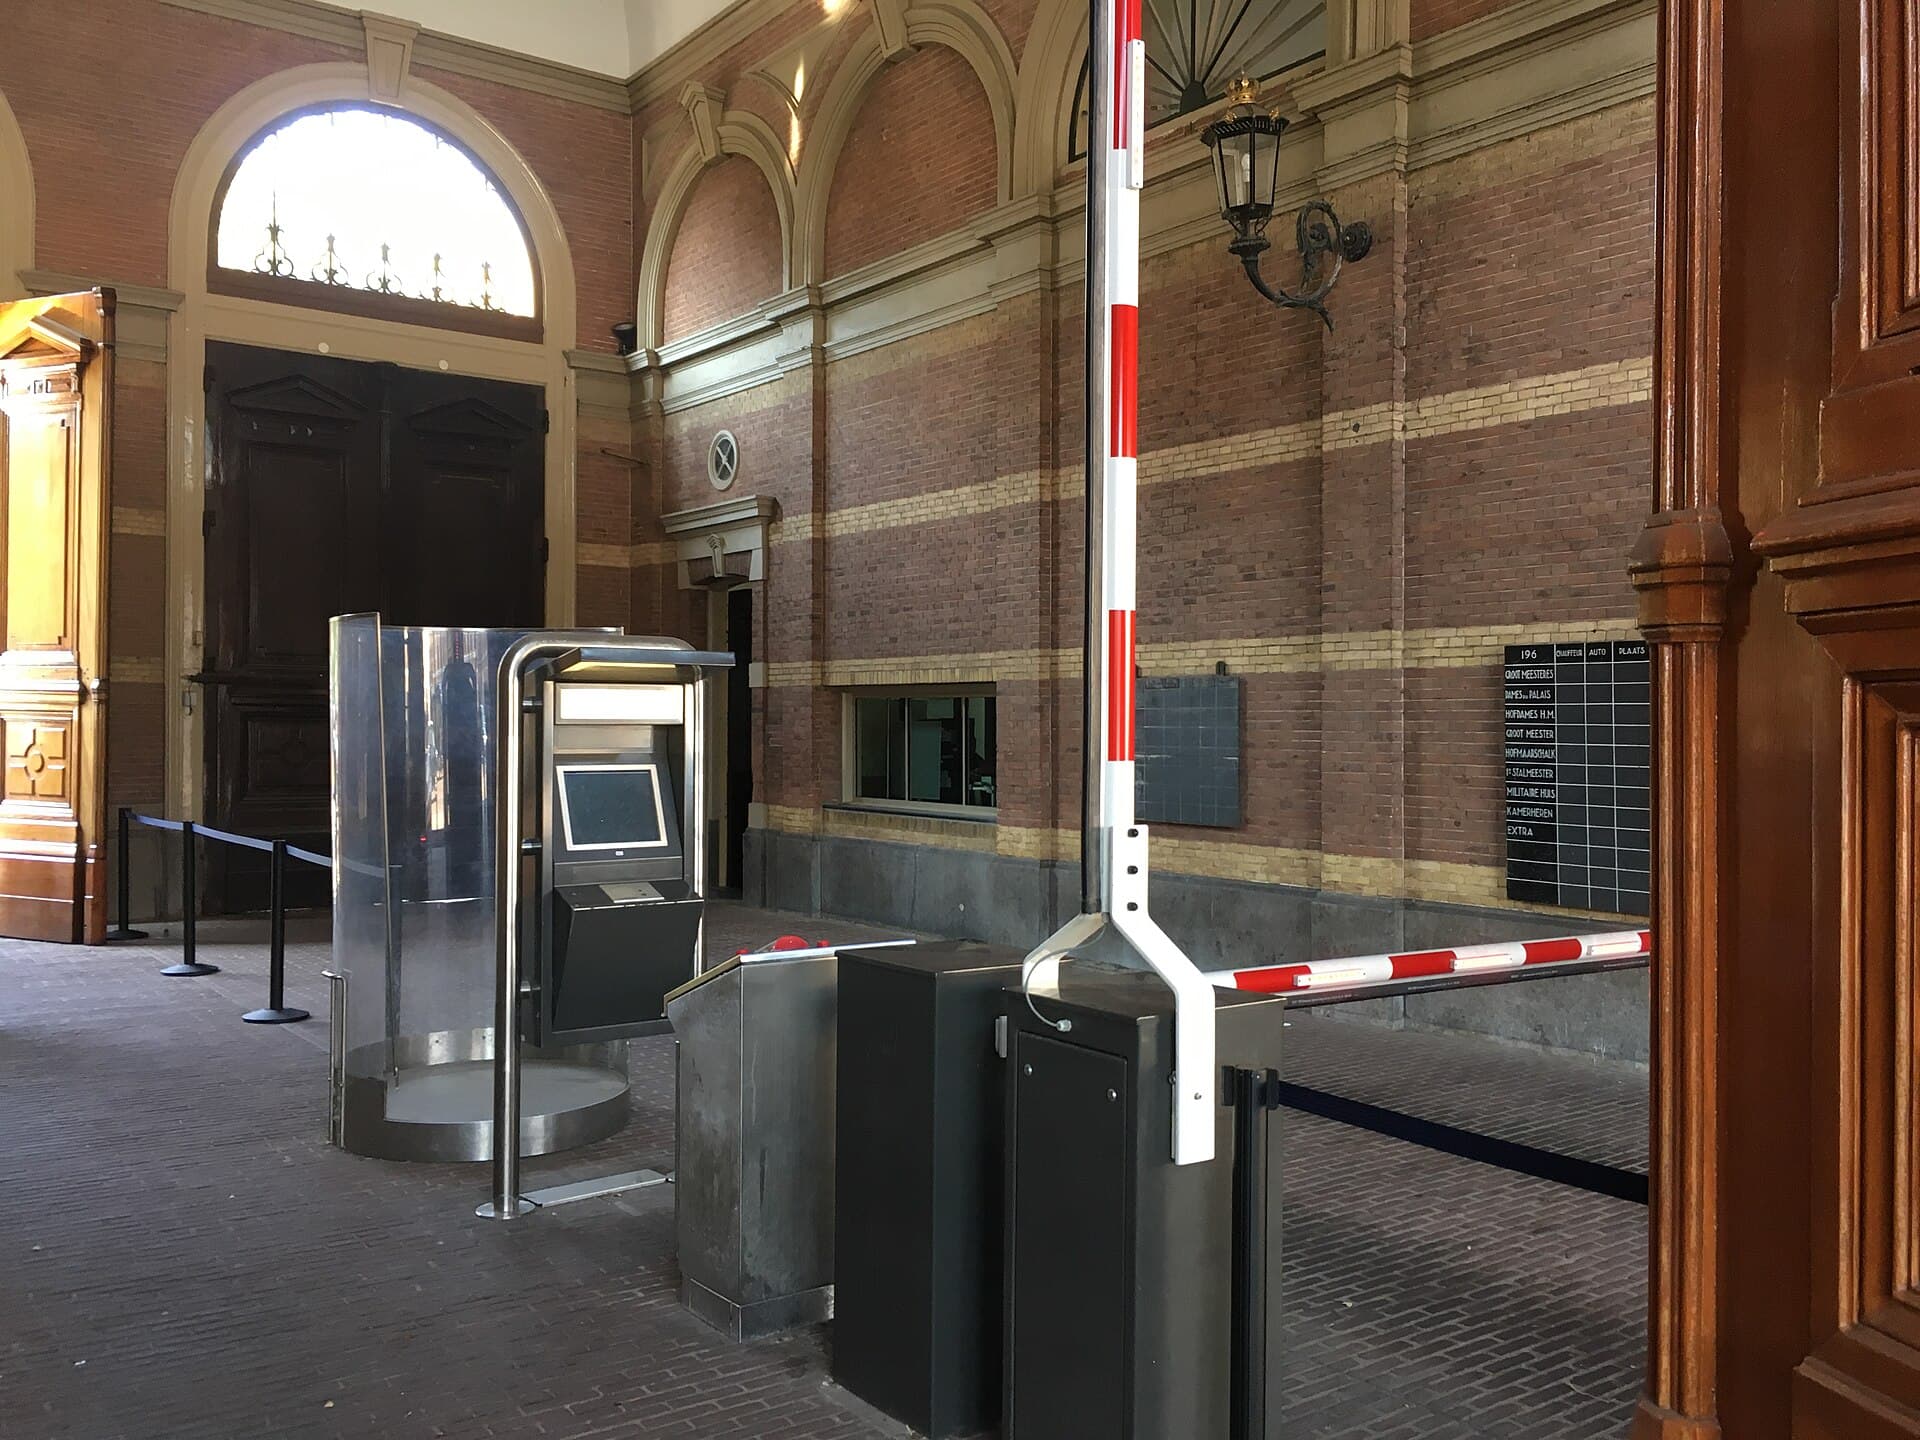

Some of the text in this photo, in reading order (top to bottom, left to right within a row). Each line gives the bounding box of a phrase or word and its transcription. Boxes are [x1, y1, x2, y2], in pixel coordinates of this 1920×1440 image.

[1521, 649, 1537, 660] 196
[1588, 648, 1607, 656] AUTO
[1618, 646, 1646, 655] PLAATS
[1529, 690, 1551, 699] PALAIS
[1505, 709, 1538, 719] HOFDAMES
[1506, 729, 1554, 739] GROOT MEESTER
[1506, 787, 1556, 799] MILITAIRE HUIS
[1506, 806, 1553, 818] KAMERHEREN
[1508, 825, 1534, 836] EXTRA
